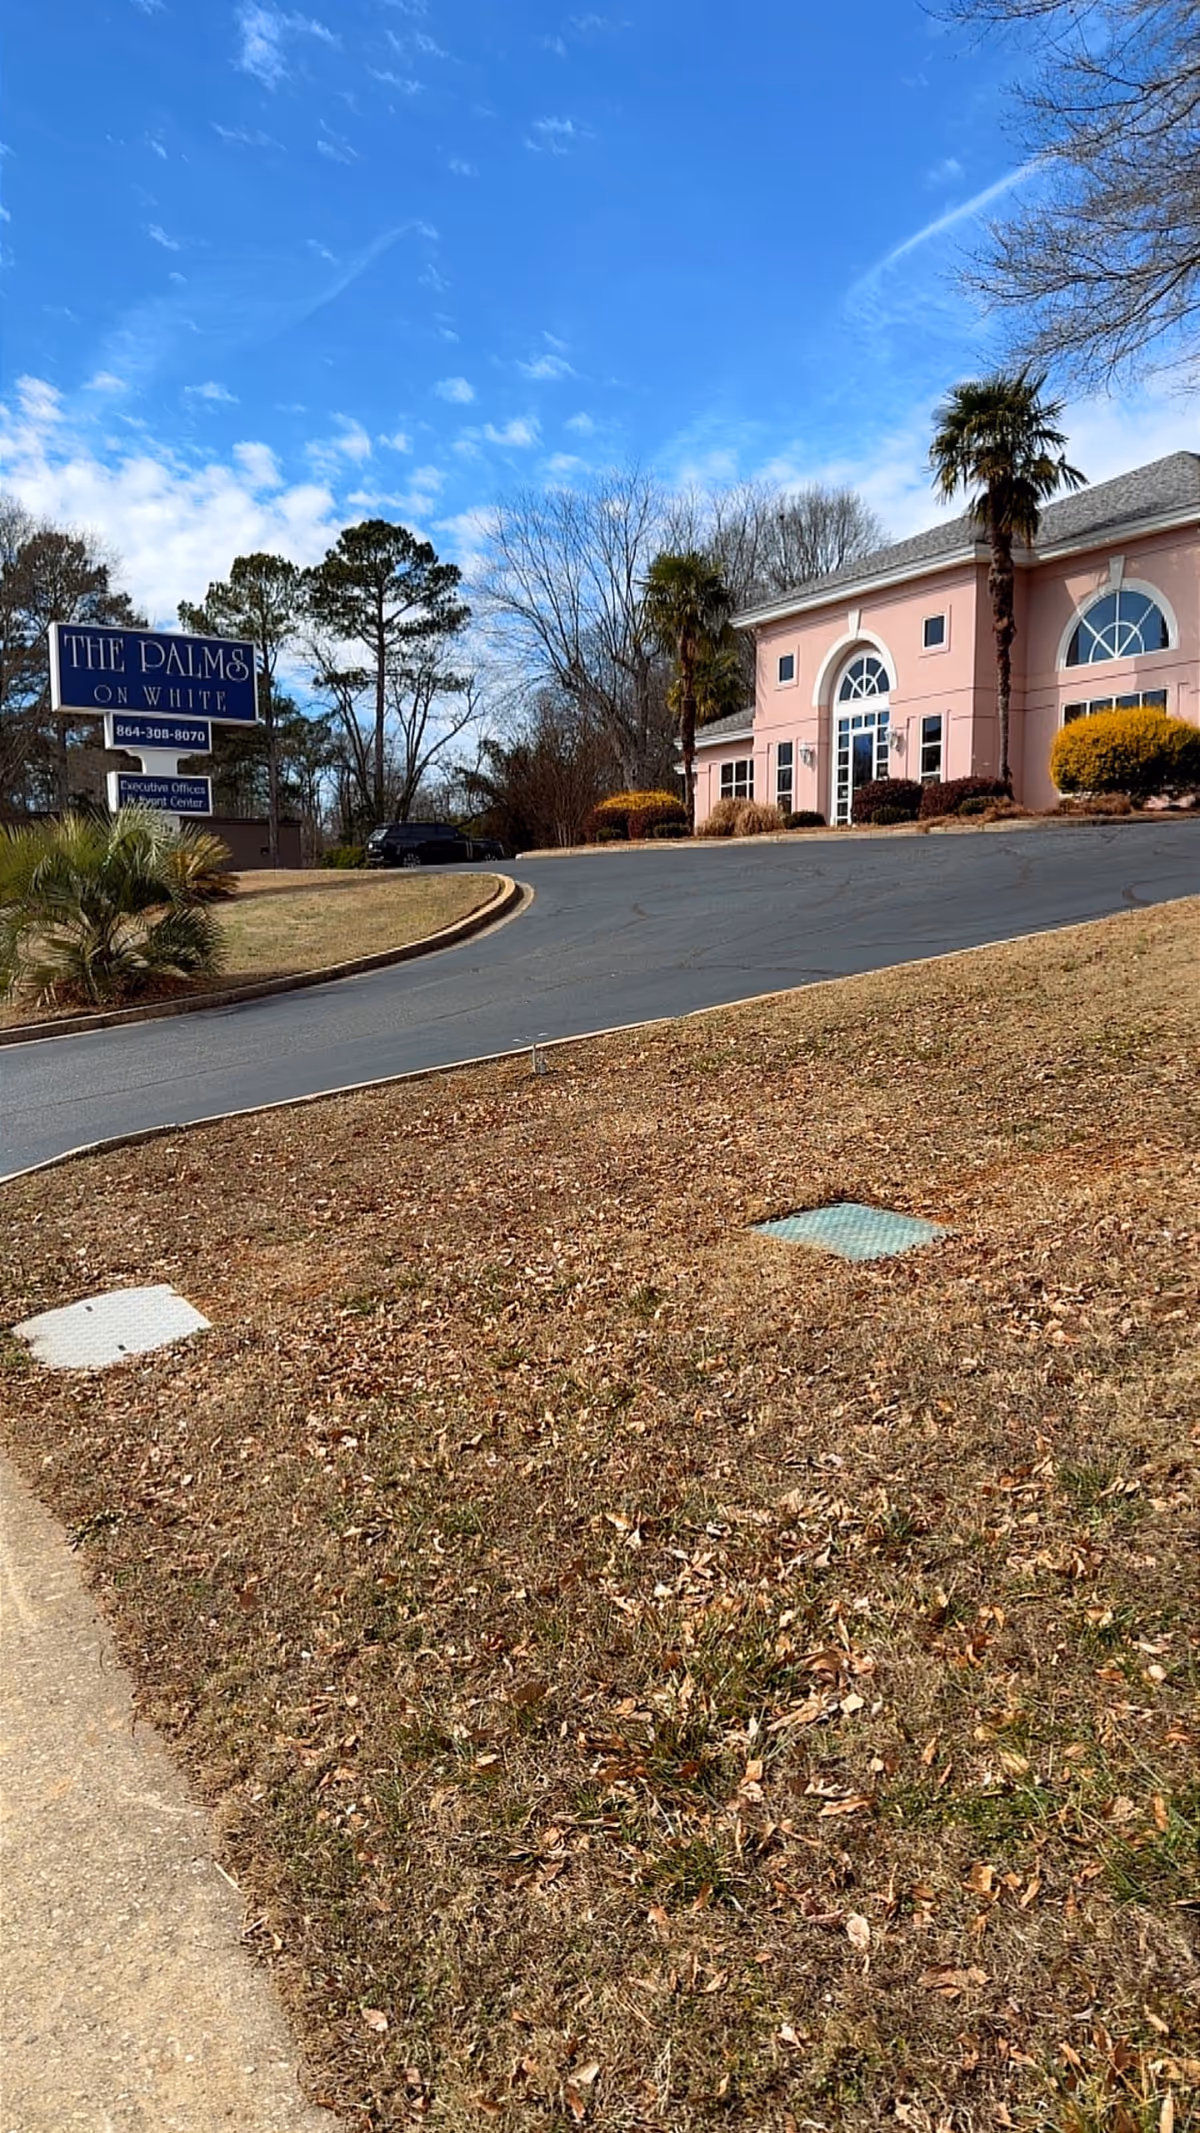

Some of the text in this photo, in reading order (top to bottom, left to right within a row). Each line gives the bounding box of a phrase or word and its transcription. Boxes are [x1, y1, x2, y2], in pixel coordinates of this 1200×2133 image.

[63, 633, 249, 682] THE PALMS
[93, 684, 227, 712] ON WHITE
[116, 724, 205, 742] 864-308-8070
[120, 780, 206, 795] Executive Offices
[169, 796, 204, 808] Center
